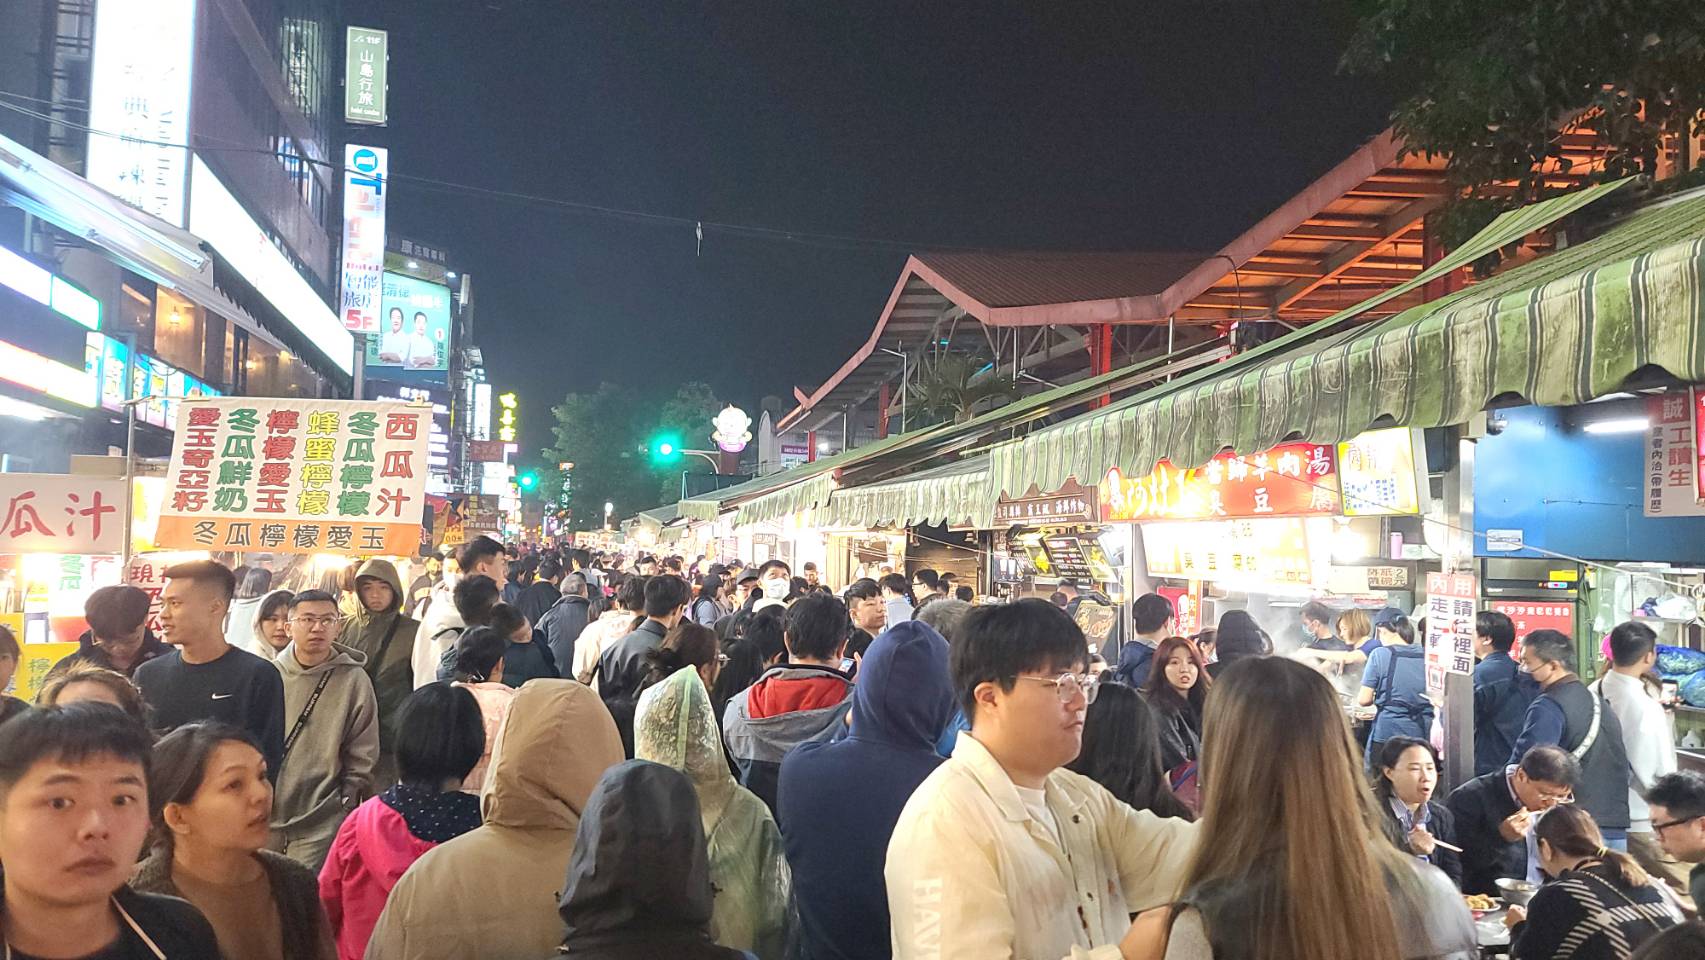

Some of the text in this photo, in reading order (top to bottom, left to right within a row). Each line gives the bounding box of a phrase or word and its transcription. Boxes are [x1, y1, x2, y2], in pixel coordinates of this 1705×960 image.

[358, 49, 374, 106] 山島行旅
[346, 309, 373, 330] 5F
[171, 407, 221, 513] 愛玉奇亞籽
[212, 408, 261, 513] 冬瓜鮮奶
[253, 409, 300, 514] 檸檬愛玉
[296, 410, 340, 516] 蜂蜜檸檬
[337, 411, 381, 517] 冬瓜檸檬
[375, 412, 420, 518] 西瓜汁
[1668, 427, 1692, 487] 工讀生
[0, 490, 117, 541] 瓜汁
[193, 521, 387, 550] 冬瓜檸檬愛玉
